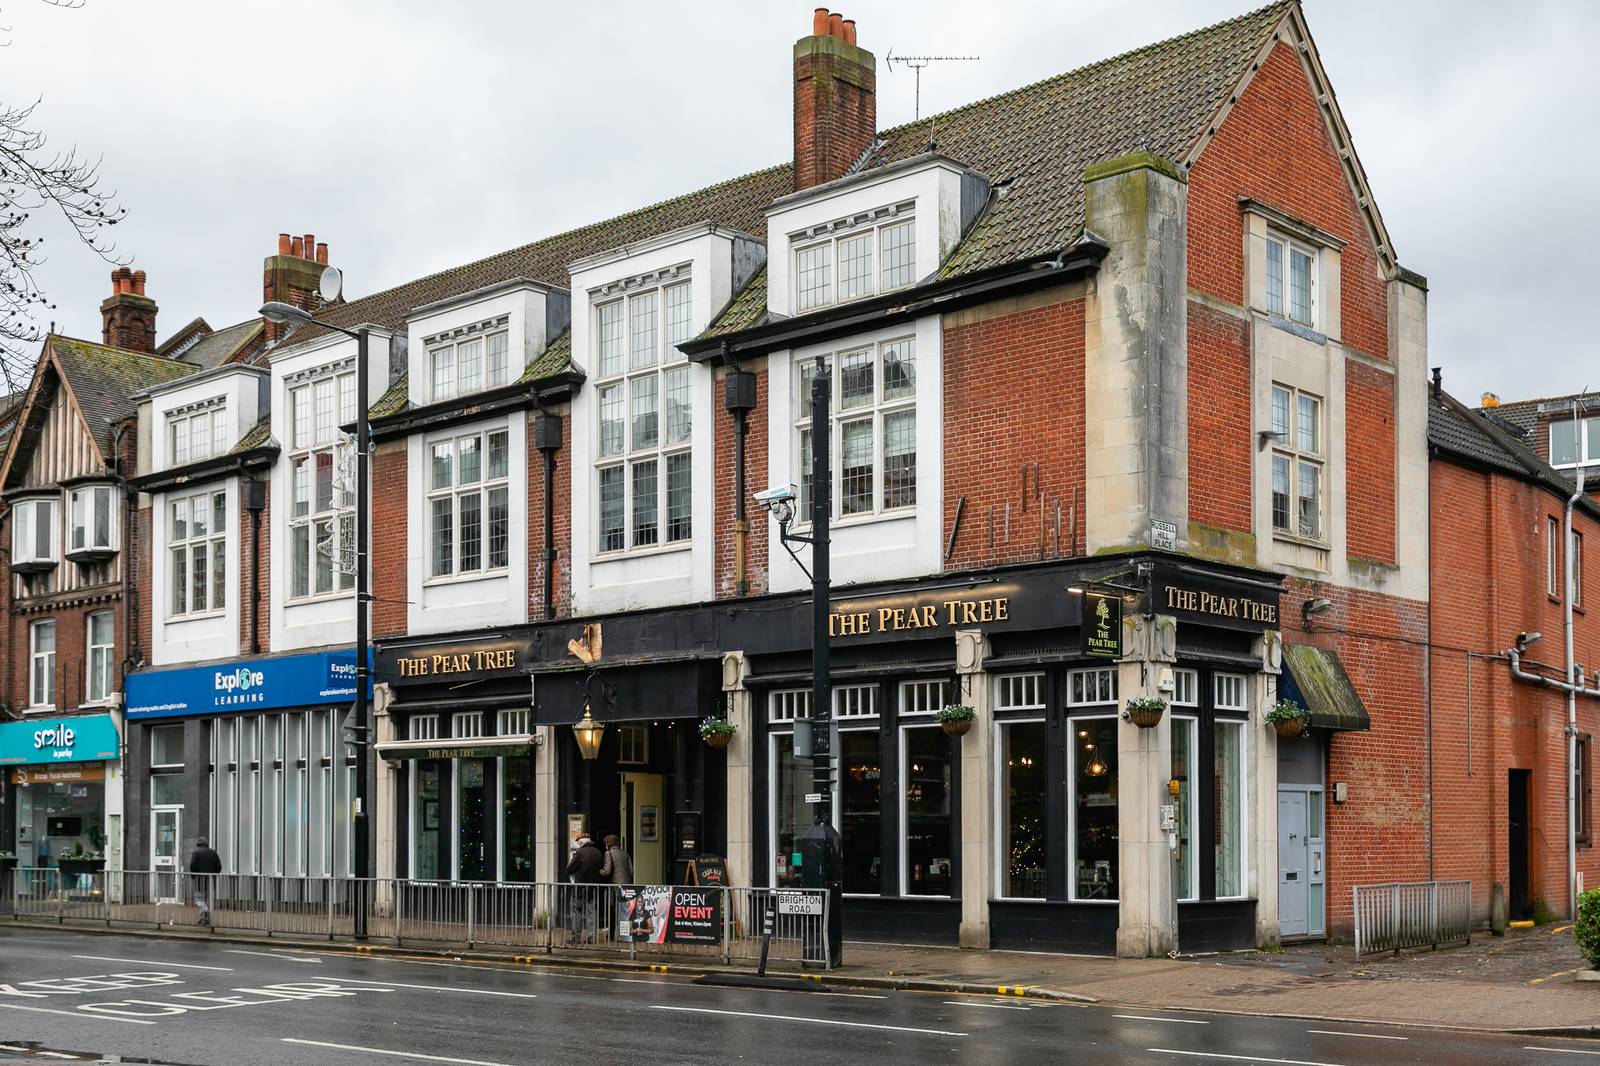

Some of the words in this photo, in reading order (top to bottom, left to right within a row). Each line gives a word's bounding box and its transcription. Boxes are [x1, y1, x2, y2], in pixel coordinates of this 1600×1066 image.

[1151, 520, 1175, 533] RUSSELL
[1157, 530, 1169, 540] HILL
[1155, 538, 1172, 550] PLACE
[1165, 585, 1197, 611] THE
[1199, 591, 1238, 617] PEAR
[1240, 598, 1276, 623] TREE
[829, 612, 870, 637] THE
[877, 604, 938, 632] PEAR
[944, 597, 1009, 625] TREE
[1097, 629, 1109, 639] THE
[1088, 637, 1103, 647] PEAR
[1104, 639, 1118, 649] TREE
[397, 658, 428, 677] THE
[432, 653, 471, 674] PEAR
[473, 649, 516, 671] TREE
[215, 668, 264, 693] Explore
[214, 693, 264, 706] LEARNING
[33, 723, 74, 749] smile
[428, 749, 441, 758] THE
[441, 749, 458, 758] PEAR
[459, 748, 475, 757] TREE
[675, 893, 705, 906] OPEN
[779, 895, 821, 905] BRIGHTON
[674, 906, 713, 919] EVENT
[789, 904, 811, 914] ROAD
[0, 972, 186, 998] KEEP
[77, 983, 395, 1016] CLEAR
